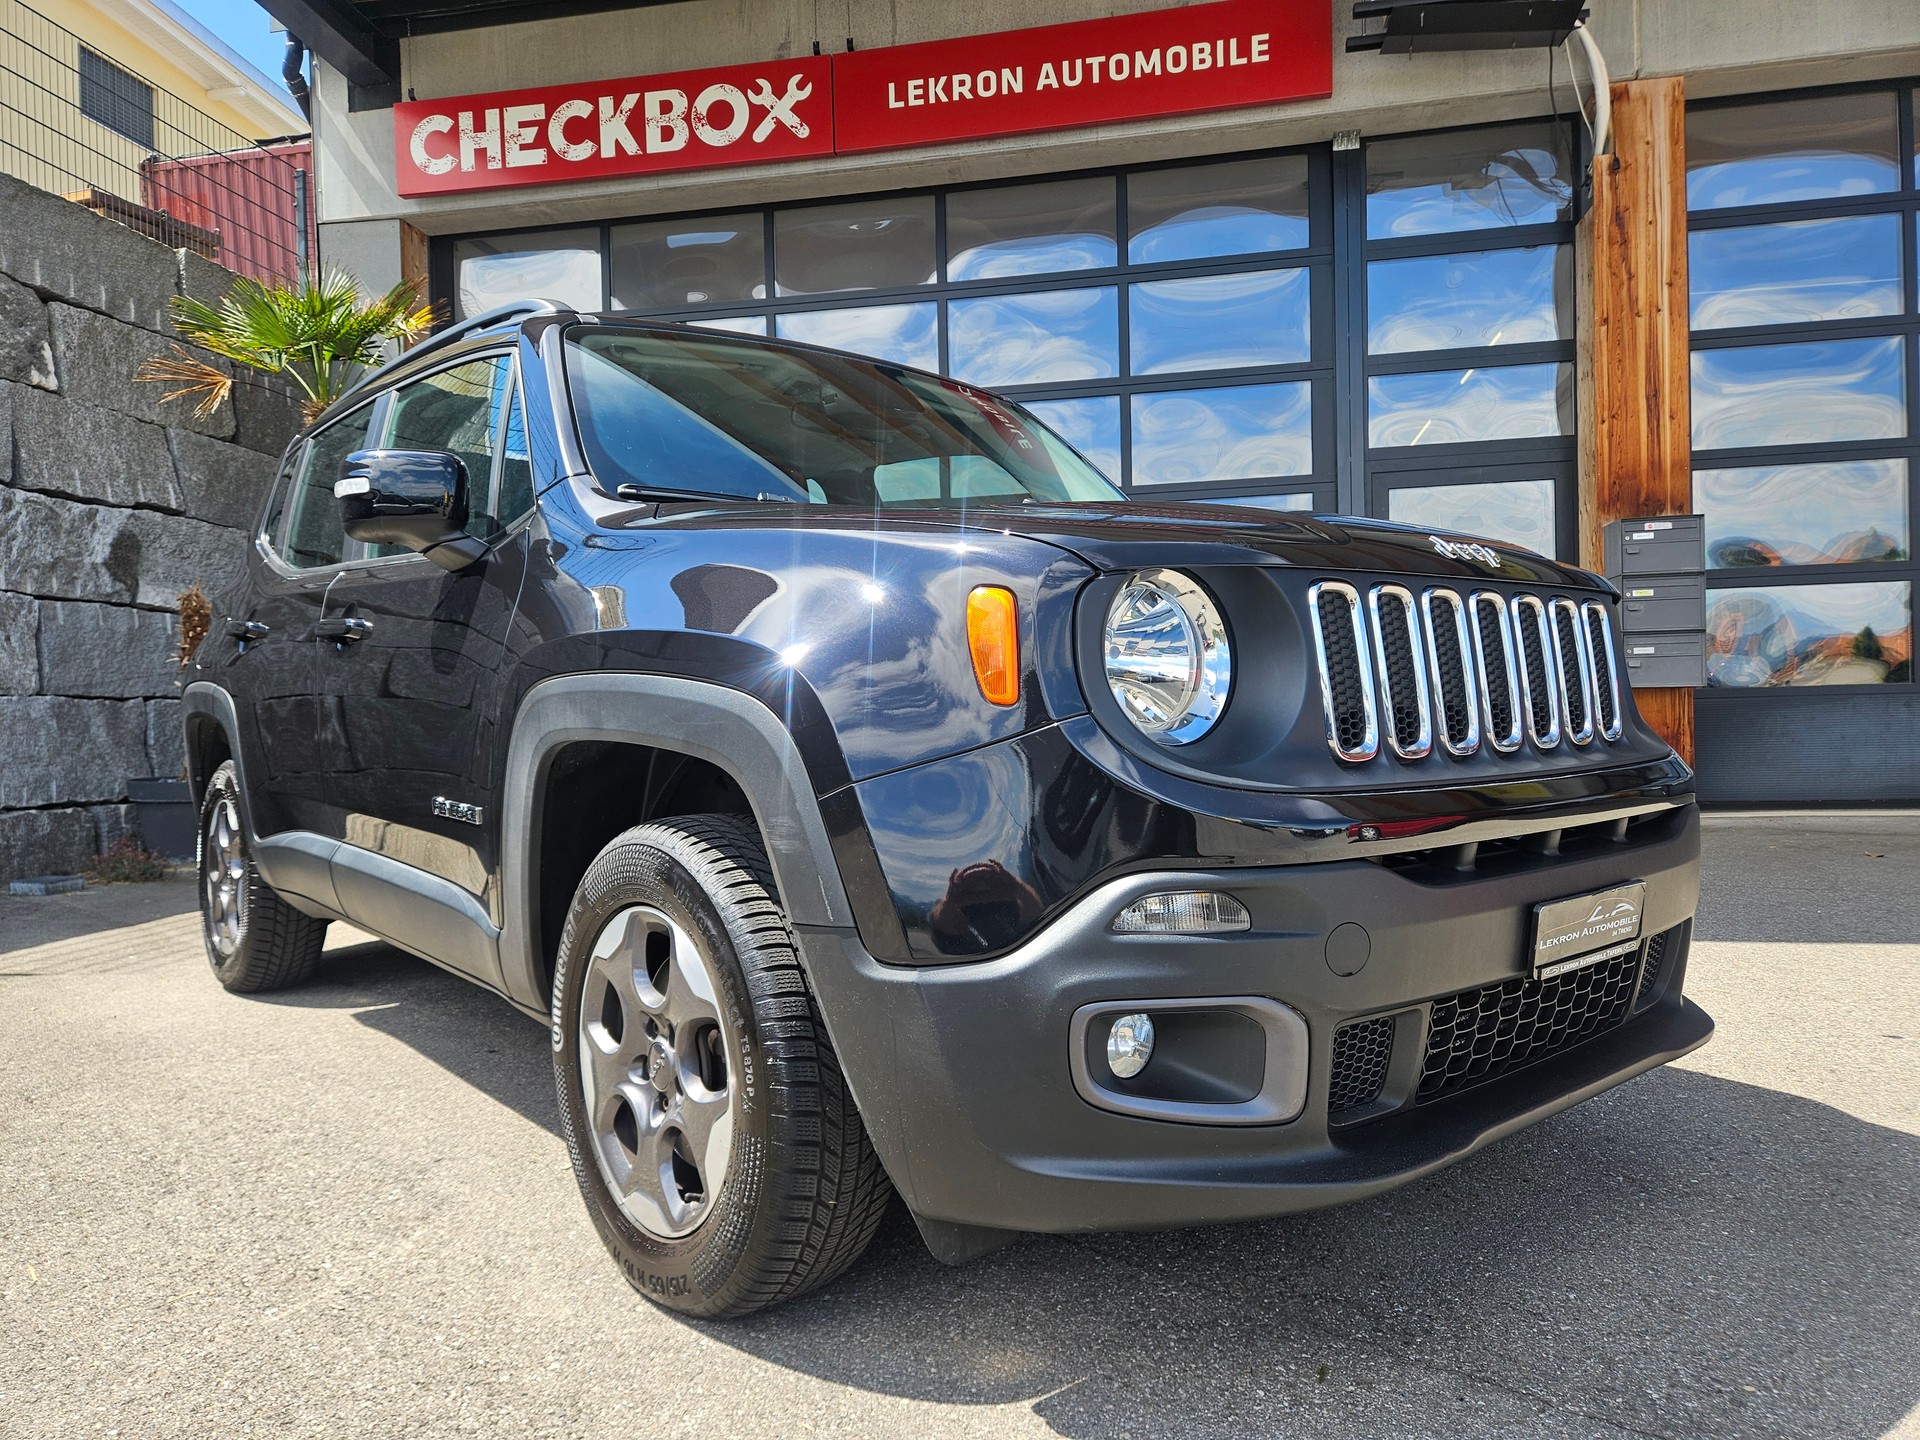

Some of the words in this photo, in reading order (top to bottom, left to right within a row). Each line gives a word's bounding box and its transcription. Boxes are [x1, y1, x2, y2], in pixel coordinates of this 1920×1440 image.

[888, 66, 1023, 109] LEKRON
[1036, 33, 1270, 91] AUTOMOBILE
[1428, 534, 1501, 568] Jeep
[1540, 931, 1580, 949] LEKRON
[1581, 915, 1638, 936] AUTOMOBILE
[552, 912, 577, 1053] Continental
[742, 1055, 754, 1081] 870
